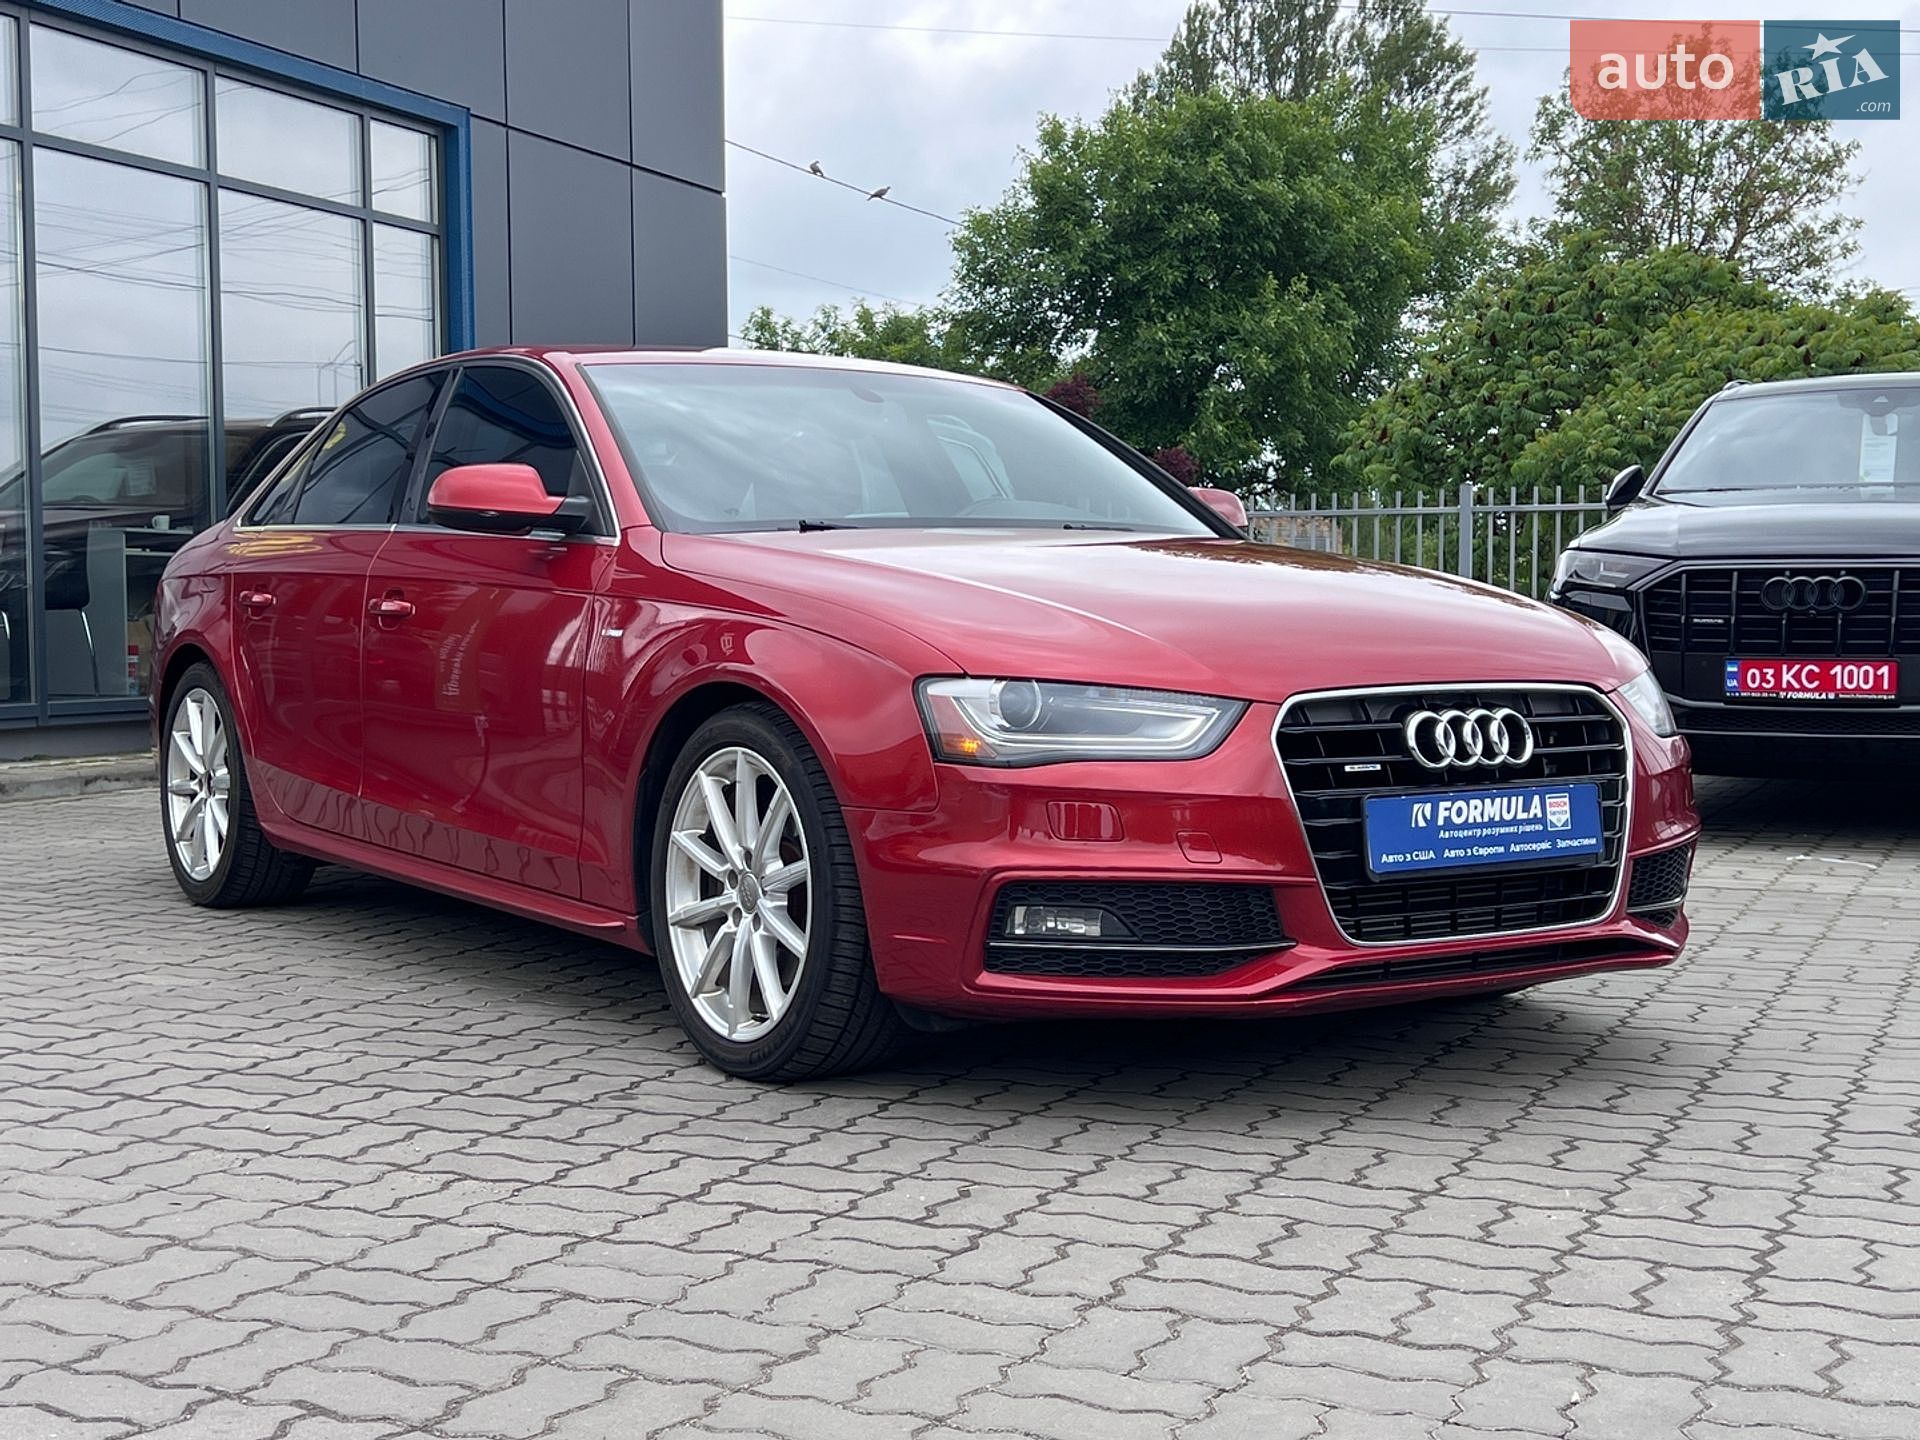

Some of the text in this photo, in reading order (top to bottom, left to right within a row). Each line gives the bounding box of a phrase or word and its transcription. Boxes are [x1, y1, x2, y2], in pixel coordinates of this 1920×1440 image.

[1726, 679, 1738, 687] UA
[1746, 664, 1890, 690] 03 KC 1001
[1437, 794, 1543, 826] FORMULA
[1438, 828, 1482, 839] Автоцентр
[1381, 853, 1404, 863] Авто
[1412, 850, 1436, 861] США
[1443, 848, 1465, 858] Авто
[1472, 845, 1505, 857] Європи
[1509, 840, 1553, 853] Автосервіс
[1556, 838, 1597, 849] Запчастини
